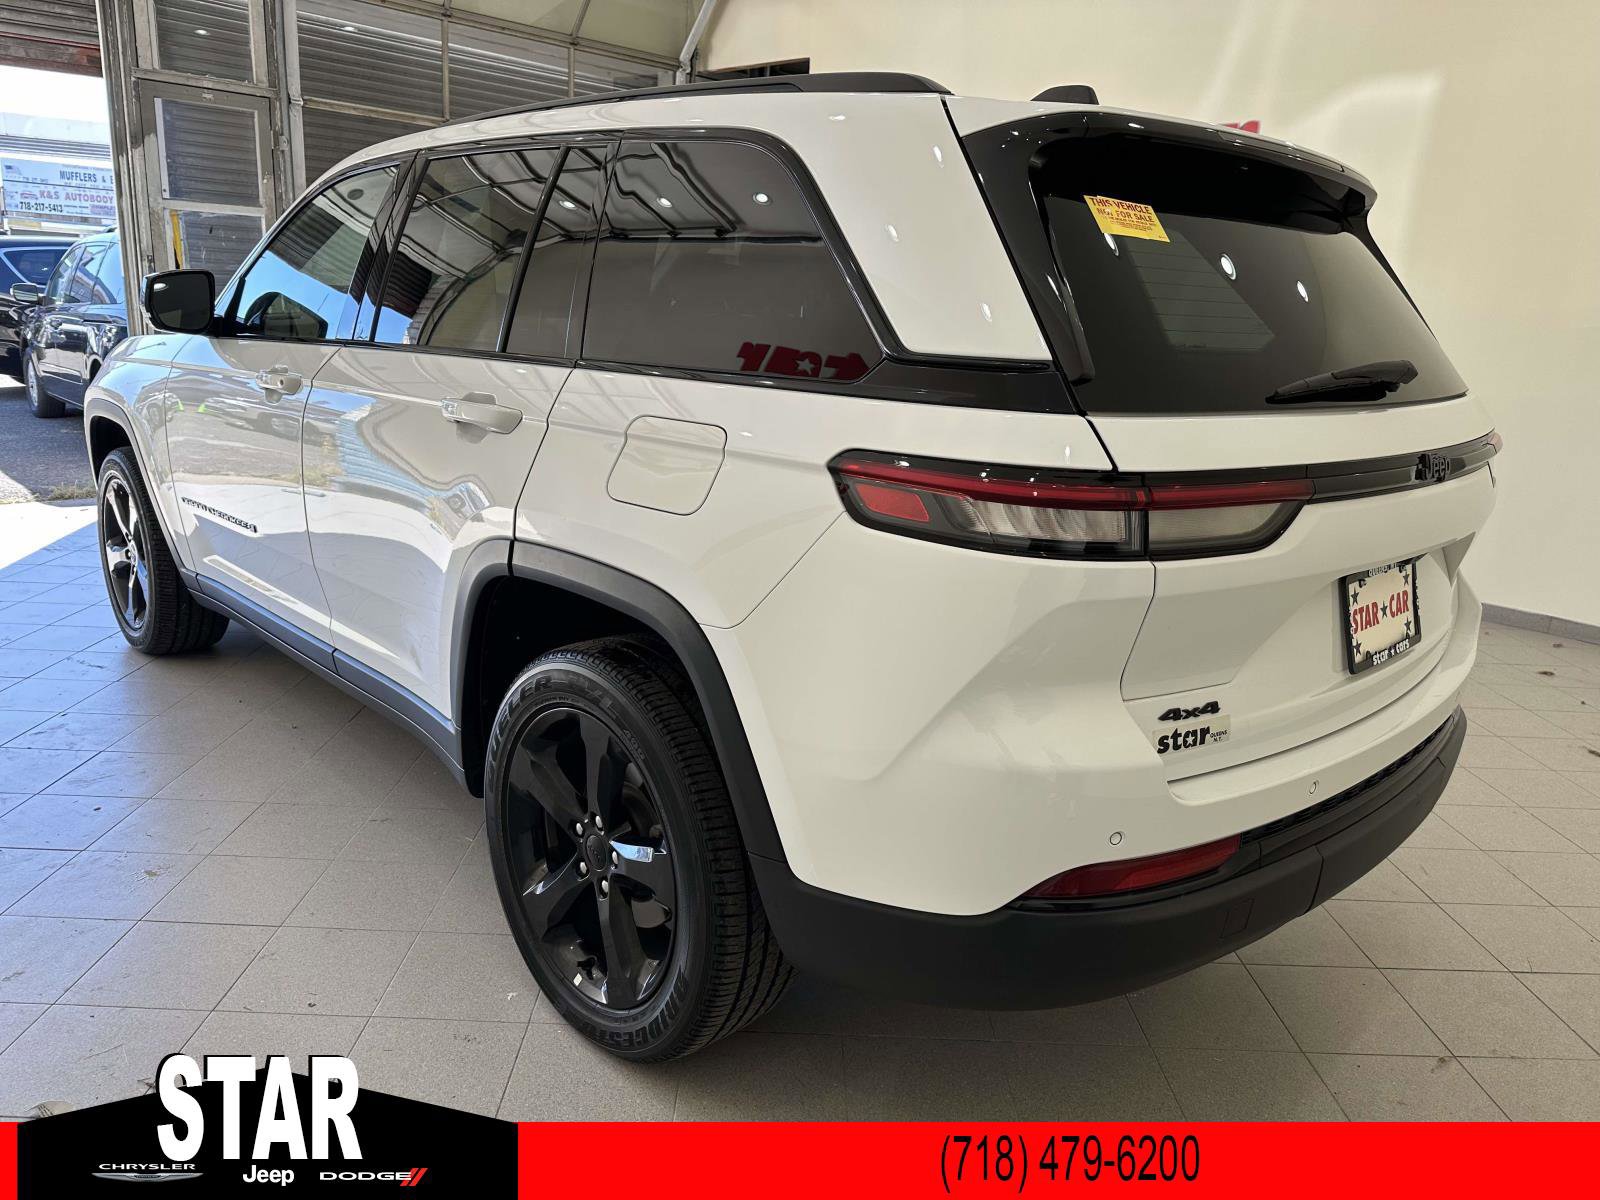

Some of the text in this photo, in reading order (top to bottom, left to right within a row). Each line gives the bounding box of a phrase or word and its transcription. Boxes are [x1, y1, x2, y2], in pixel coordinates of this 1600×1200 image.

[60, 170, 97, 183] MUFFLERS
[40, 190, 114, 204] K&S AUTOBODY
[1089, 198, 1152, 215] THIS VEHICLE
[1115, 210, 1133, 220] FOR
[1134, 213, 1155, 223] SALE
[1416, 453, 1451, 482] Jeep
[1352, 590, 1409, 635] STAR CAR
[1157, 700, 1221, 721] 4x4
[1157, 726, 1211, 754] star
